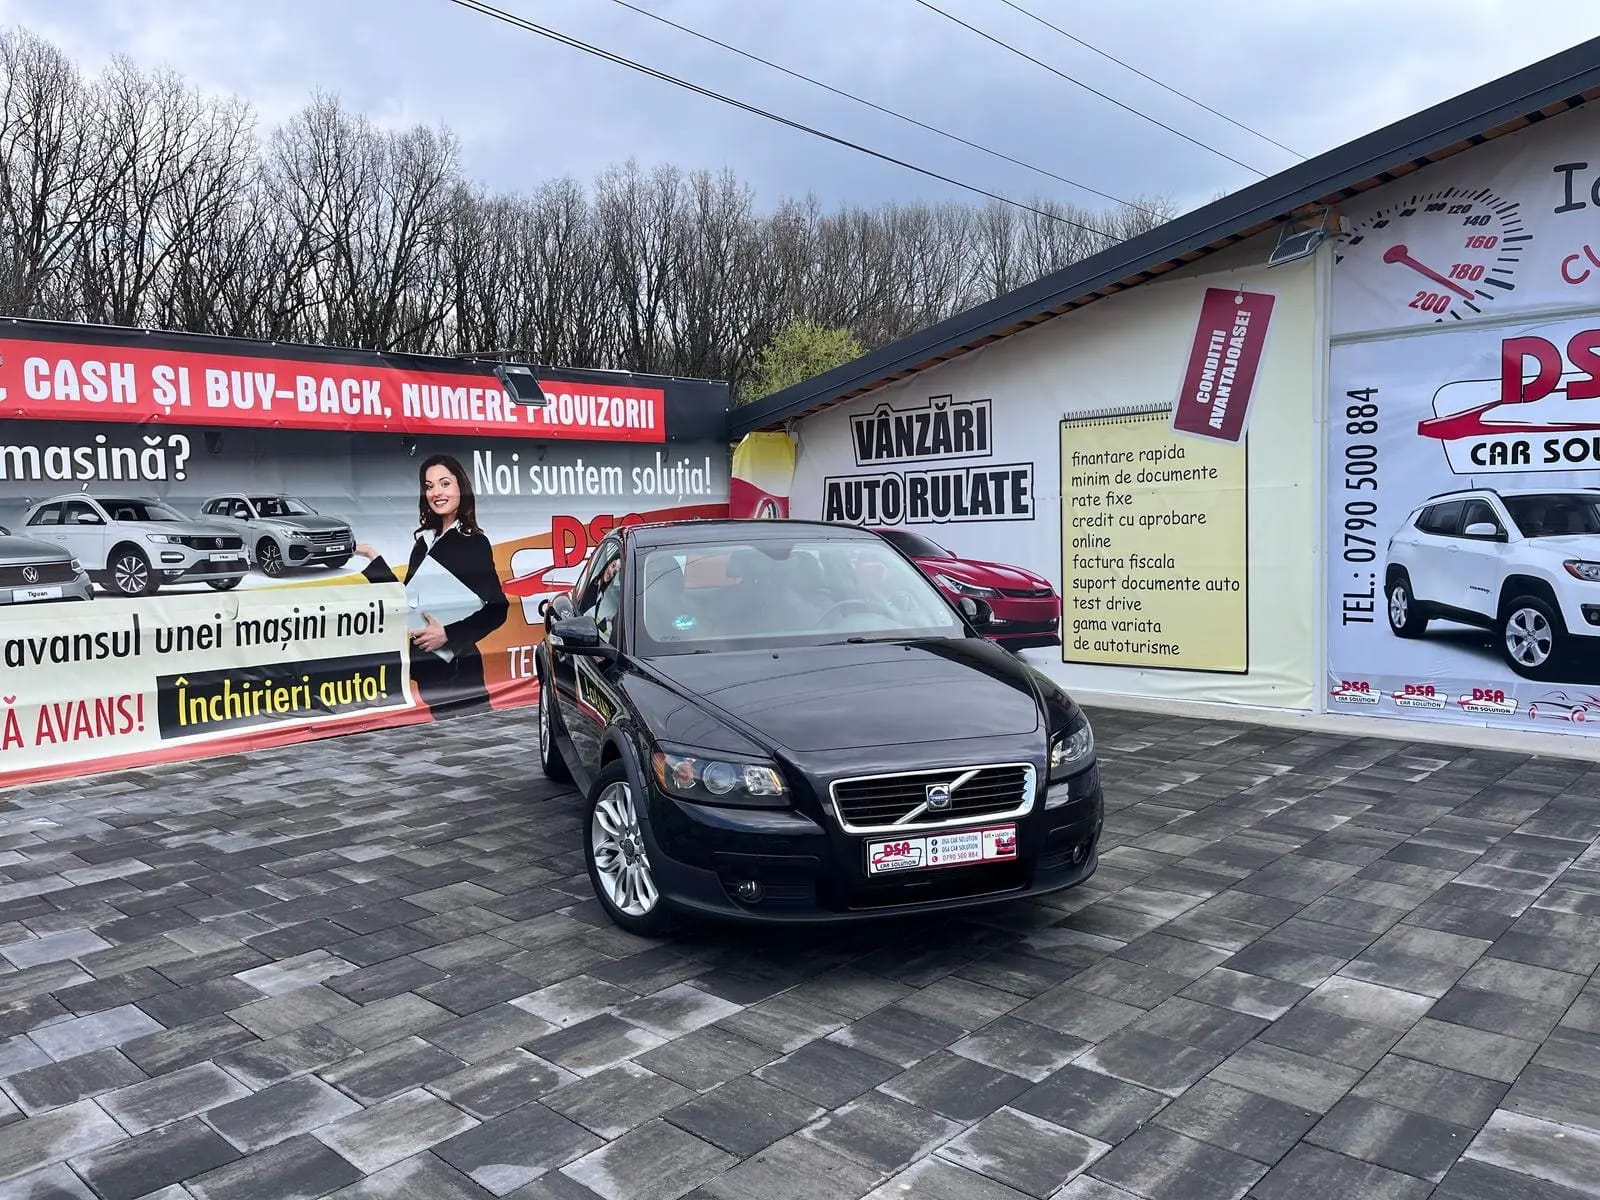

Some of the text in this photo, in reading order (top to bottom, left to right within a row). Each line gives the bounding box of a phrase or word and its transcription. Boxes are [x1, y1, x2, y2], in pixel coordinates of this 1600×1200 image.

[1447, 204, 1472, 214] 120
[1463, 215, 1491, 226] 140
[1465, 235, 1498, 249] 160
[1448, 264, 1485, 281] 180
[1408, 290, 1451, 314] 200
[1196, 330, 1226, 404] CONDITII
[1208, 310, 1251, 430] AVANTAJOASE!
[24, 357, 137, 403] CASH
[152, 365, 191, 416] ȘI
[206, 369, 392, 418] BUY-BACK,
[402, 383, 518, 423] NUMERE
[855, 404, 987, 459] VÂNZĂRI
[1072, 444, 1185, 467] finantare rapida
[1471, 440, 1530, 466] CAR
[0, 434, 190, 492] mașină?
[473, 451, 711, 503] Noi suntem soluția!
[1072, 465, 1218, 487] minim de documente
[826, 469, 1029, 521] AUTO RULATE
[1072, 491, 1133, 507] rate fixe
[1343, 387, 1379, 626] TEL.: 0790 500 884
[1072, 510, 1207, 530] credit cu aprobare
[1072, 533, 1111, 548] online
[1072, 553, 1175, 570] factura fiscala
[1072, 575, 1240, 593] suport documente auto
[1073, 596, 1142, 611] test drive
[5, 600, 384, 668] avansul unei mașini noi!
[1073, 618, 1162, 634] gama variata
[1073, 636, 1180, 655] de autoturisme
[175, 664, 388, 726] Închirieri auto!
[1342, 680, 1369, 693] DSA
[1405, 685, 1434, 697] DSA
[1473, 688, 1504, 703] DSA
[1480, 706, 1511, 714] SOLUTION
[0, 693, 145, 750] Ă AVANS!
[884, 842, 910, 857] DSA
